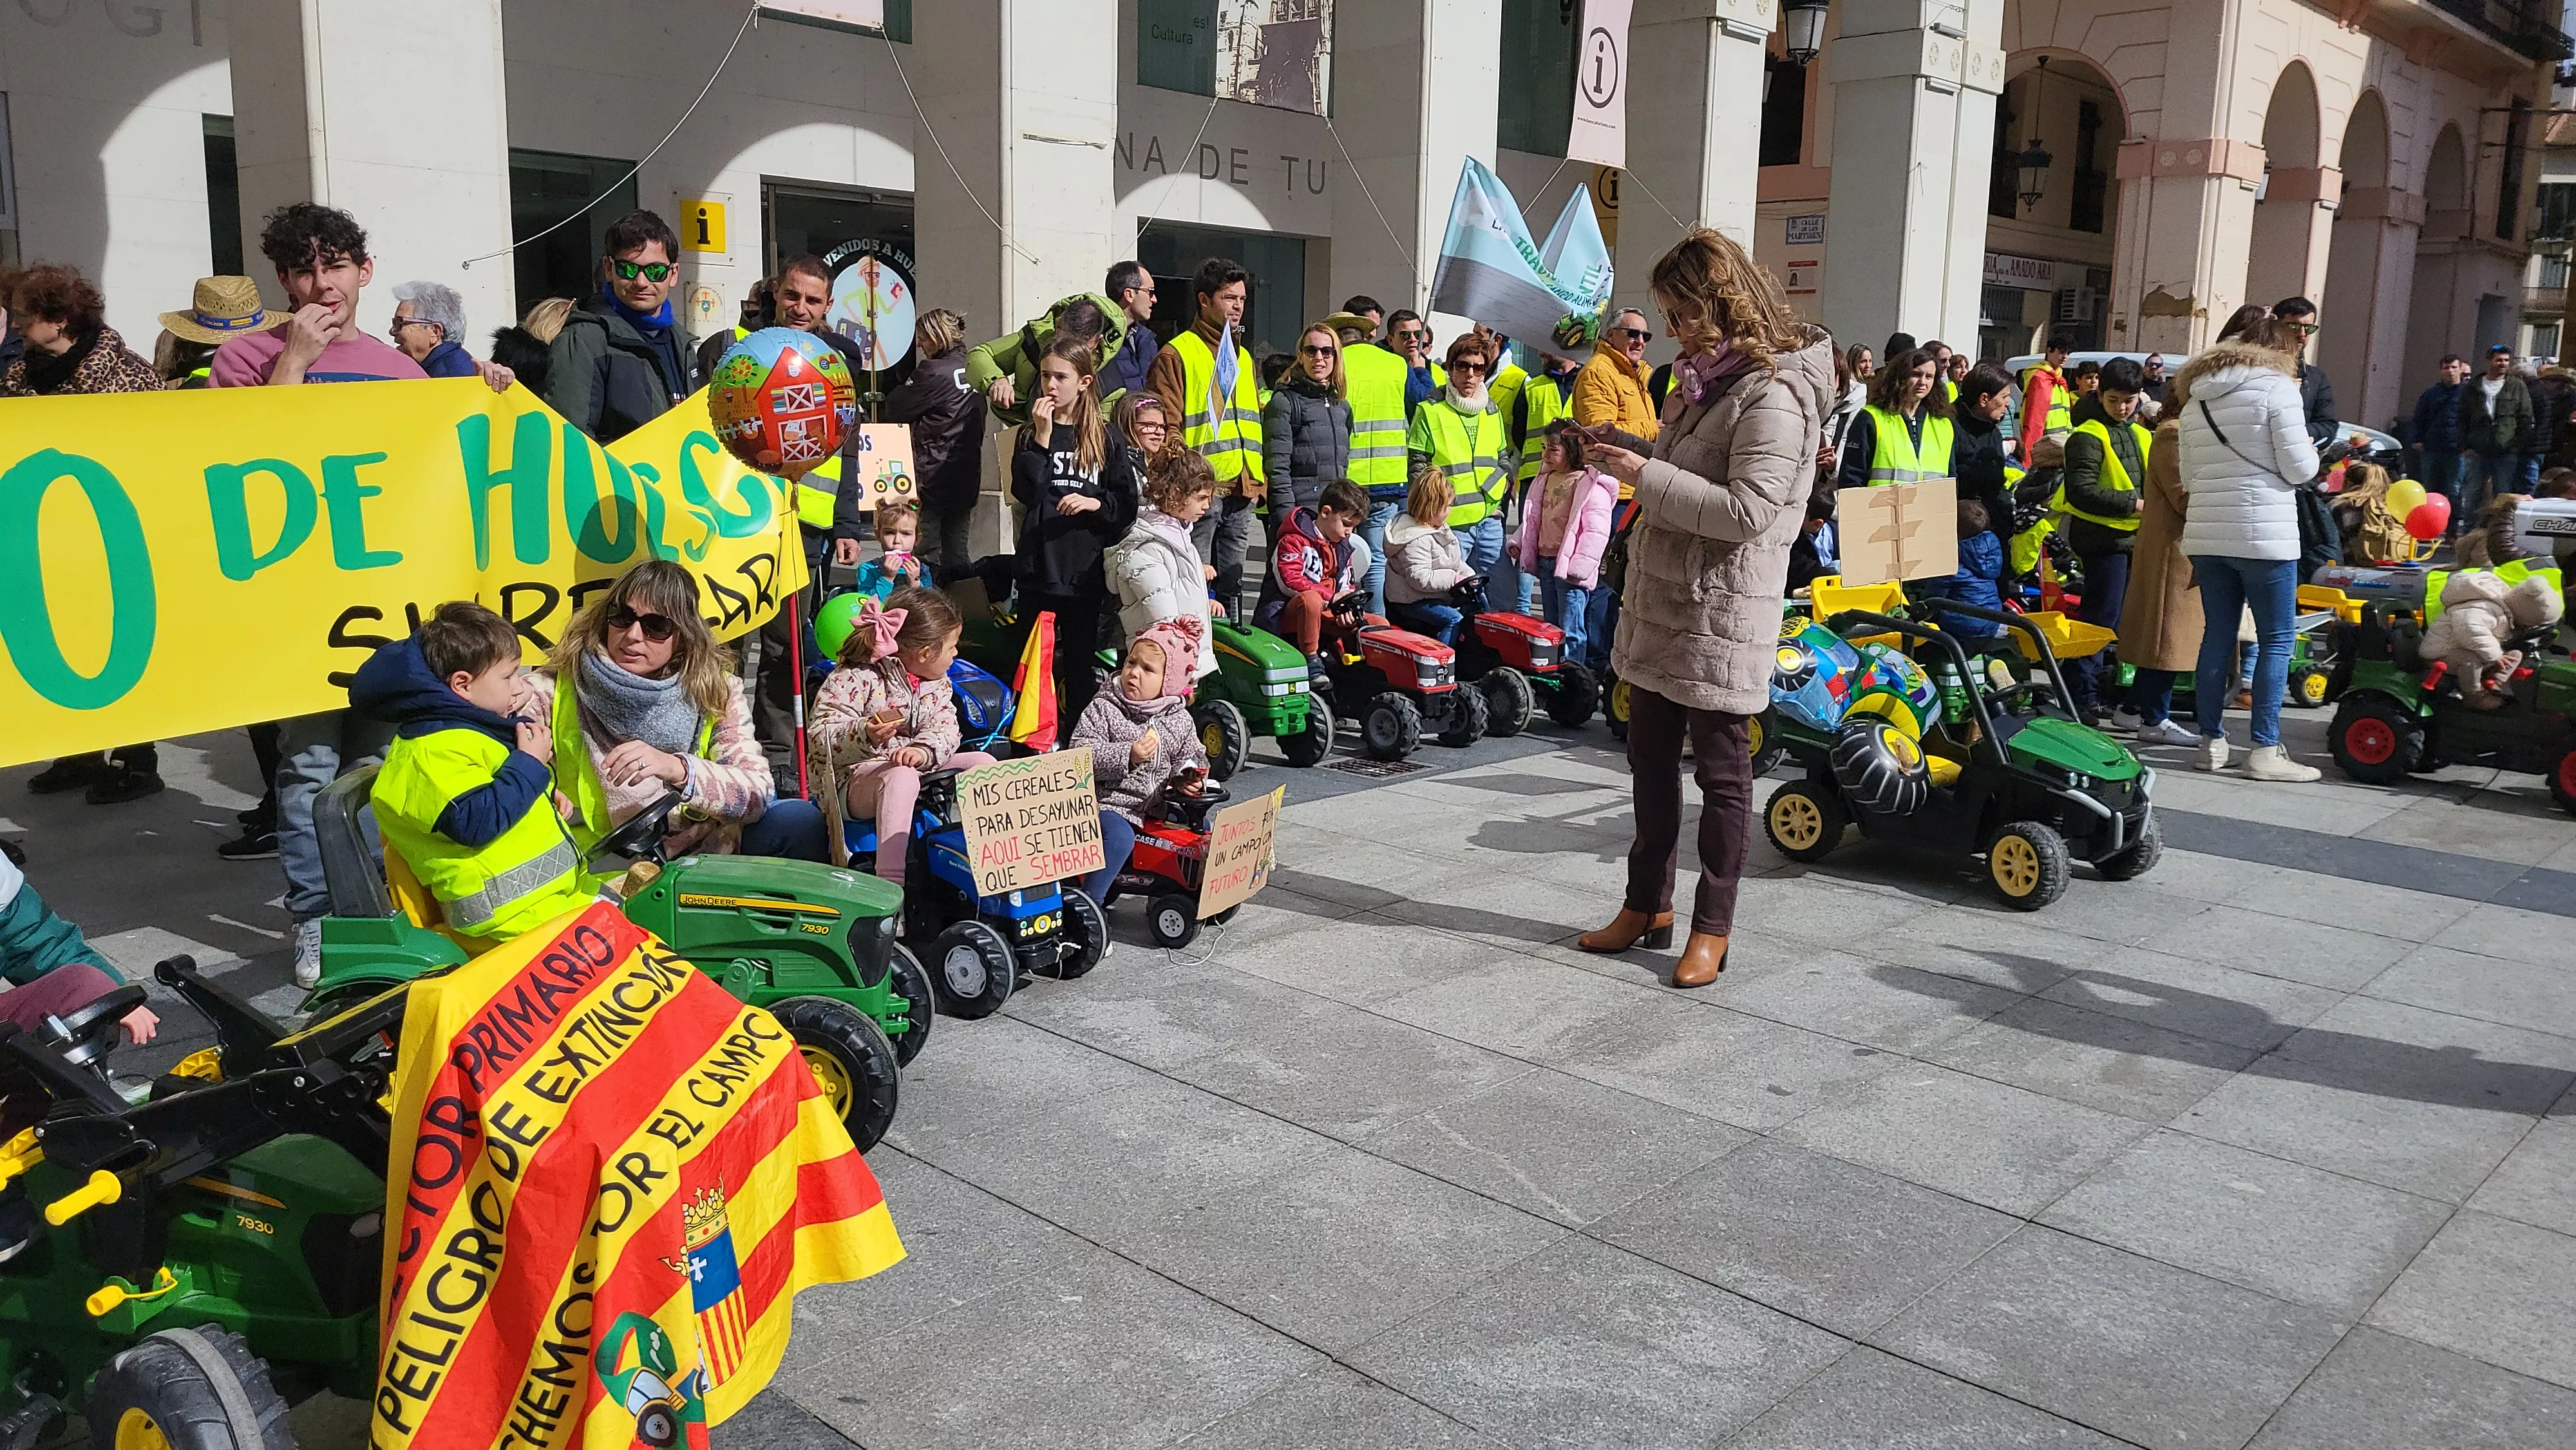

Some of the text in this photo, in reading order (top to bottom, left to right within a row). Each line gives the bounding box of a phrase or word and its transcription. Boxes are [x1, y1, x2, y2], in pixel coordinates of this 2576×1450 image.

[1152, 24, 1193, 44] Cultura
[1199, 142, 1249, 185] DE
[1280, 155, 1326, 194] TU
[882, 242, 893, 256] A
[1069, 480, 1084, 489] SELF
[204, 451, 404, 581] DE
[972, 769, 1077, 809] MIS CEREALES
[975, 795, 1095, 837] PARA DESAYUNAR
[1218, 816, 1256, 845] JUNTOS
[981, 836, 1023, 869] AQUI
[1024, 832, 1045, 856] SE
[1046, 819, 1099, 849] TIENEN
[1135, 834, 1155, 846] CASE
[1215, 850, 1227, 867] UN
[1231, 836, 1262, 861] CAMPO
[985, 865, 1018, 892] QUE
[1030, 844, 1102, 880] SEMBRAR
[1209, 865, 1248, 899] FUTURO
[800, 923, 829, 935] 7930
[450, 925, 615, 1095] PRIMARIO
[590, 1151, 669, 1237] OR
[645, 1108, 705, 1151] EL
[236, 1215, 274, 1235] 7930
[377, 1180, 505, 1436] PELIGRO
[486, 1100, 551, 1183] DE
